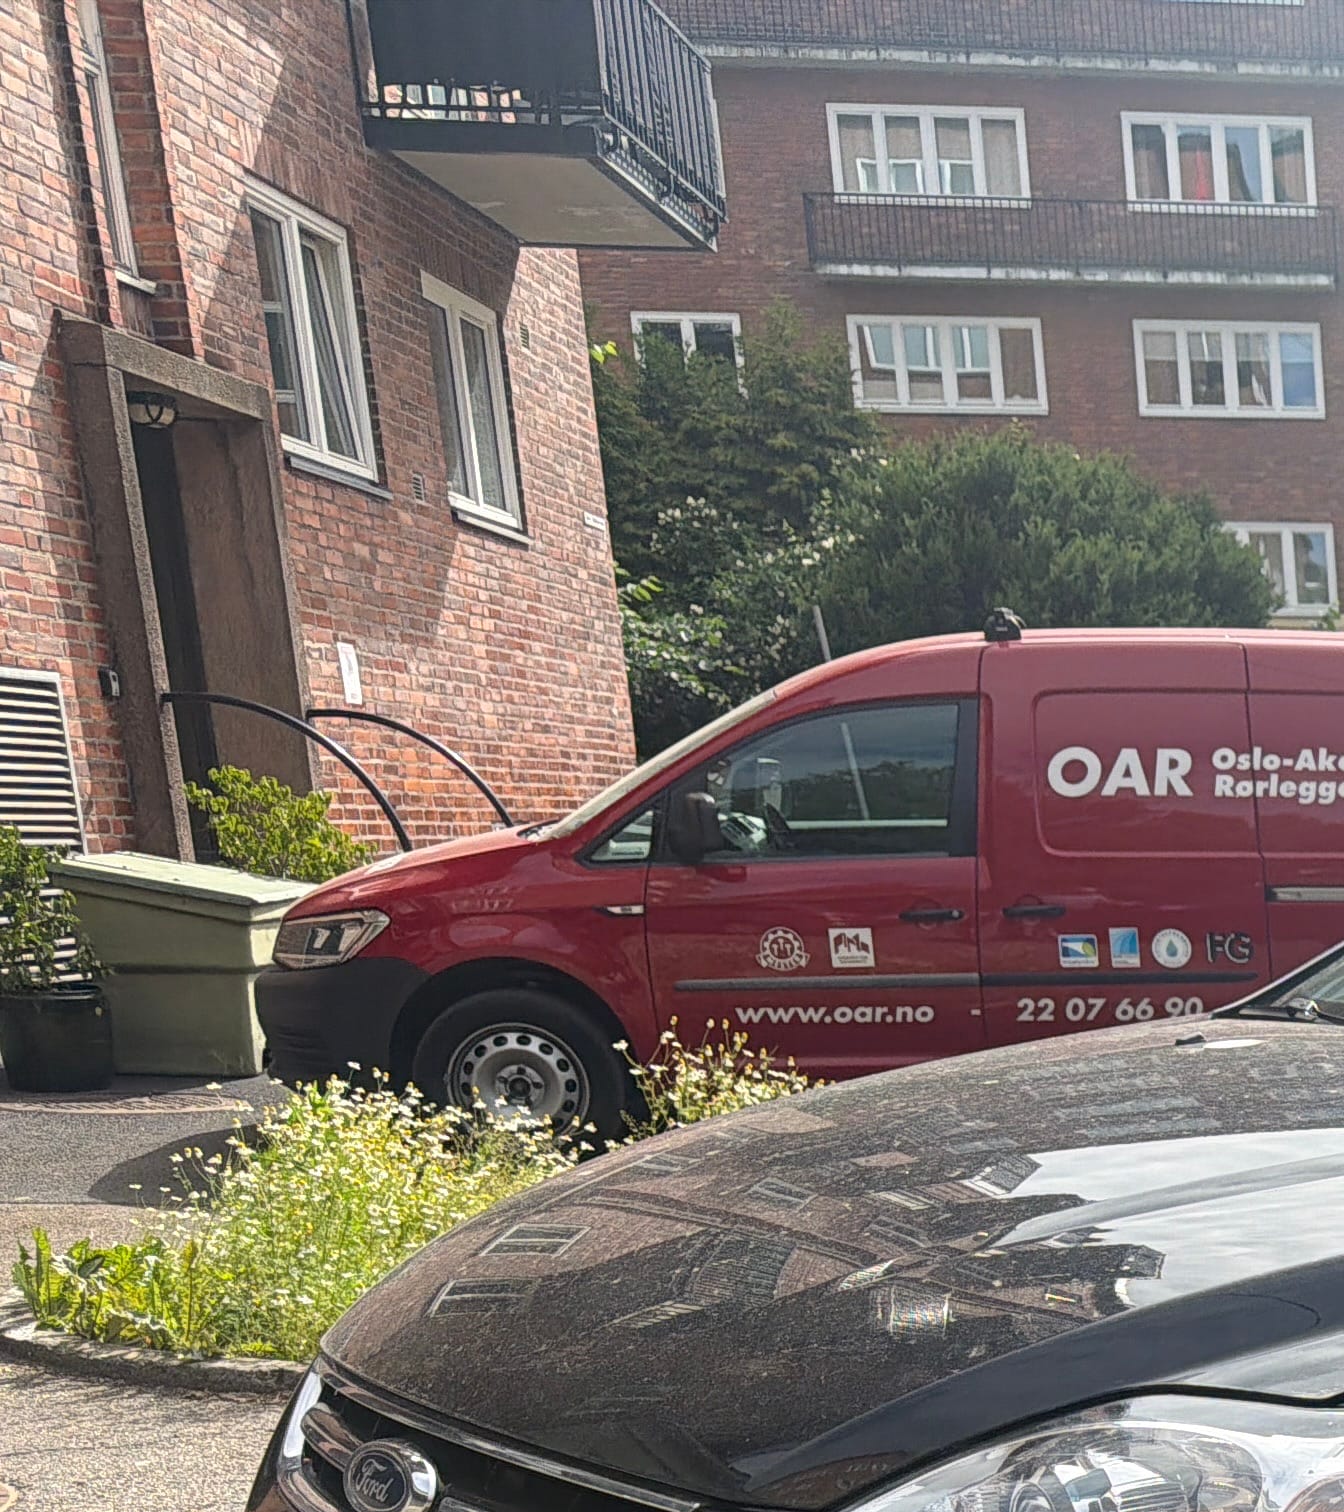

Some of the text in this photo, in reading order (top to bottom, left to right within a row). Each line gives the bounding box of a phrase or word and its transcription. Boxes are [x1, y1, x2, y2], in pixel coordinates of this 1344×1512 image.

[1047, 745, 1194, 798] OAR
[734, 1005, 935, 1024] www.oar.no
[1015, 997, 1056, 1022] 22
[1065, 997, 1107, 1022] 07
[1115, 997, 1155, 1022] 66
[1164, 996, 1204, 1018] 90
[355, 1458, 395, 1503] Ford
